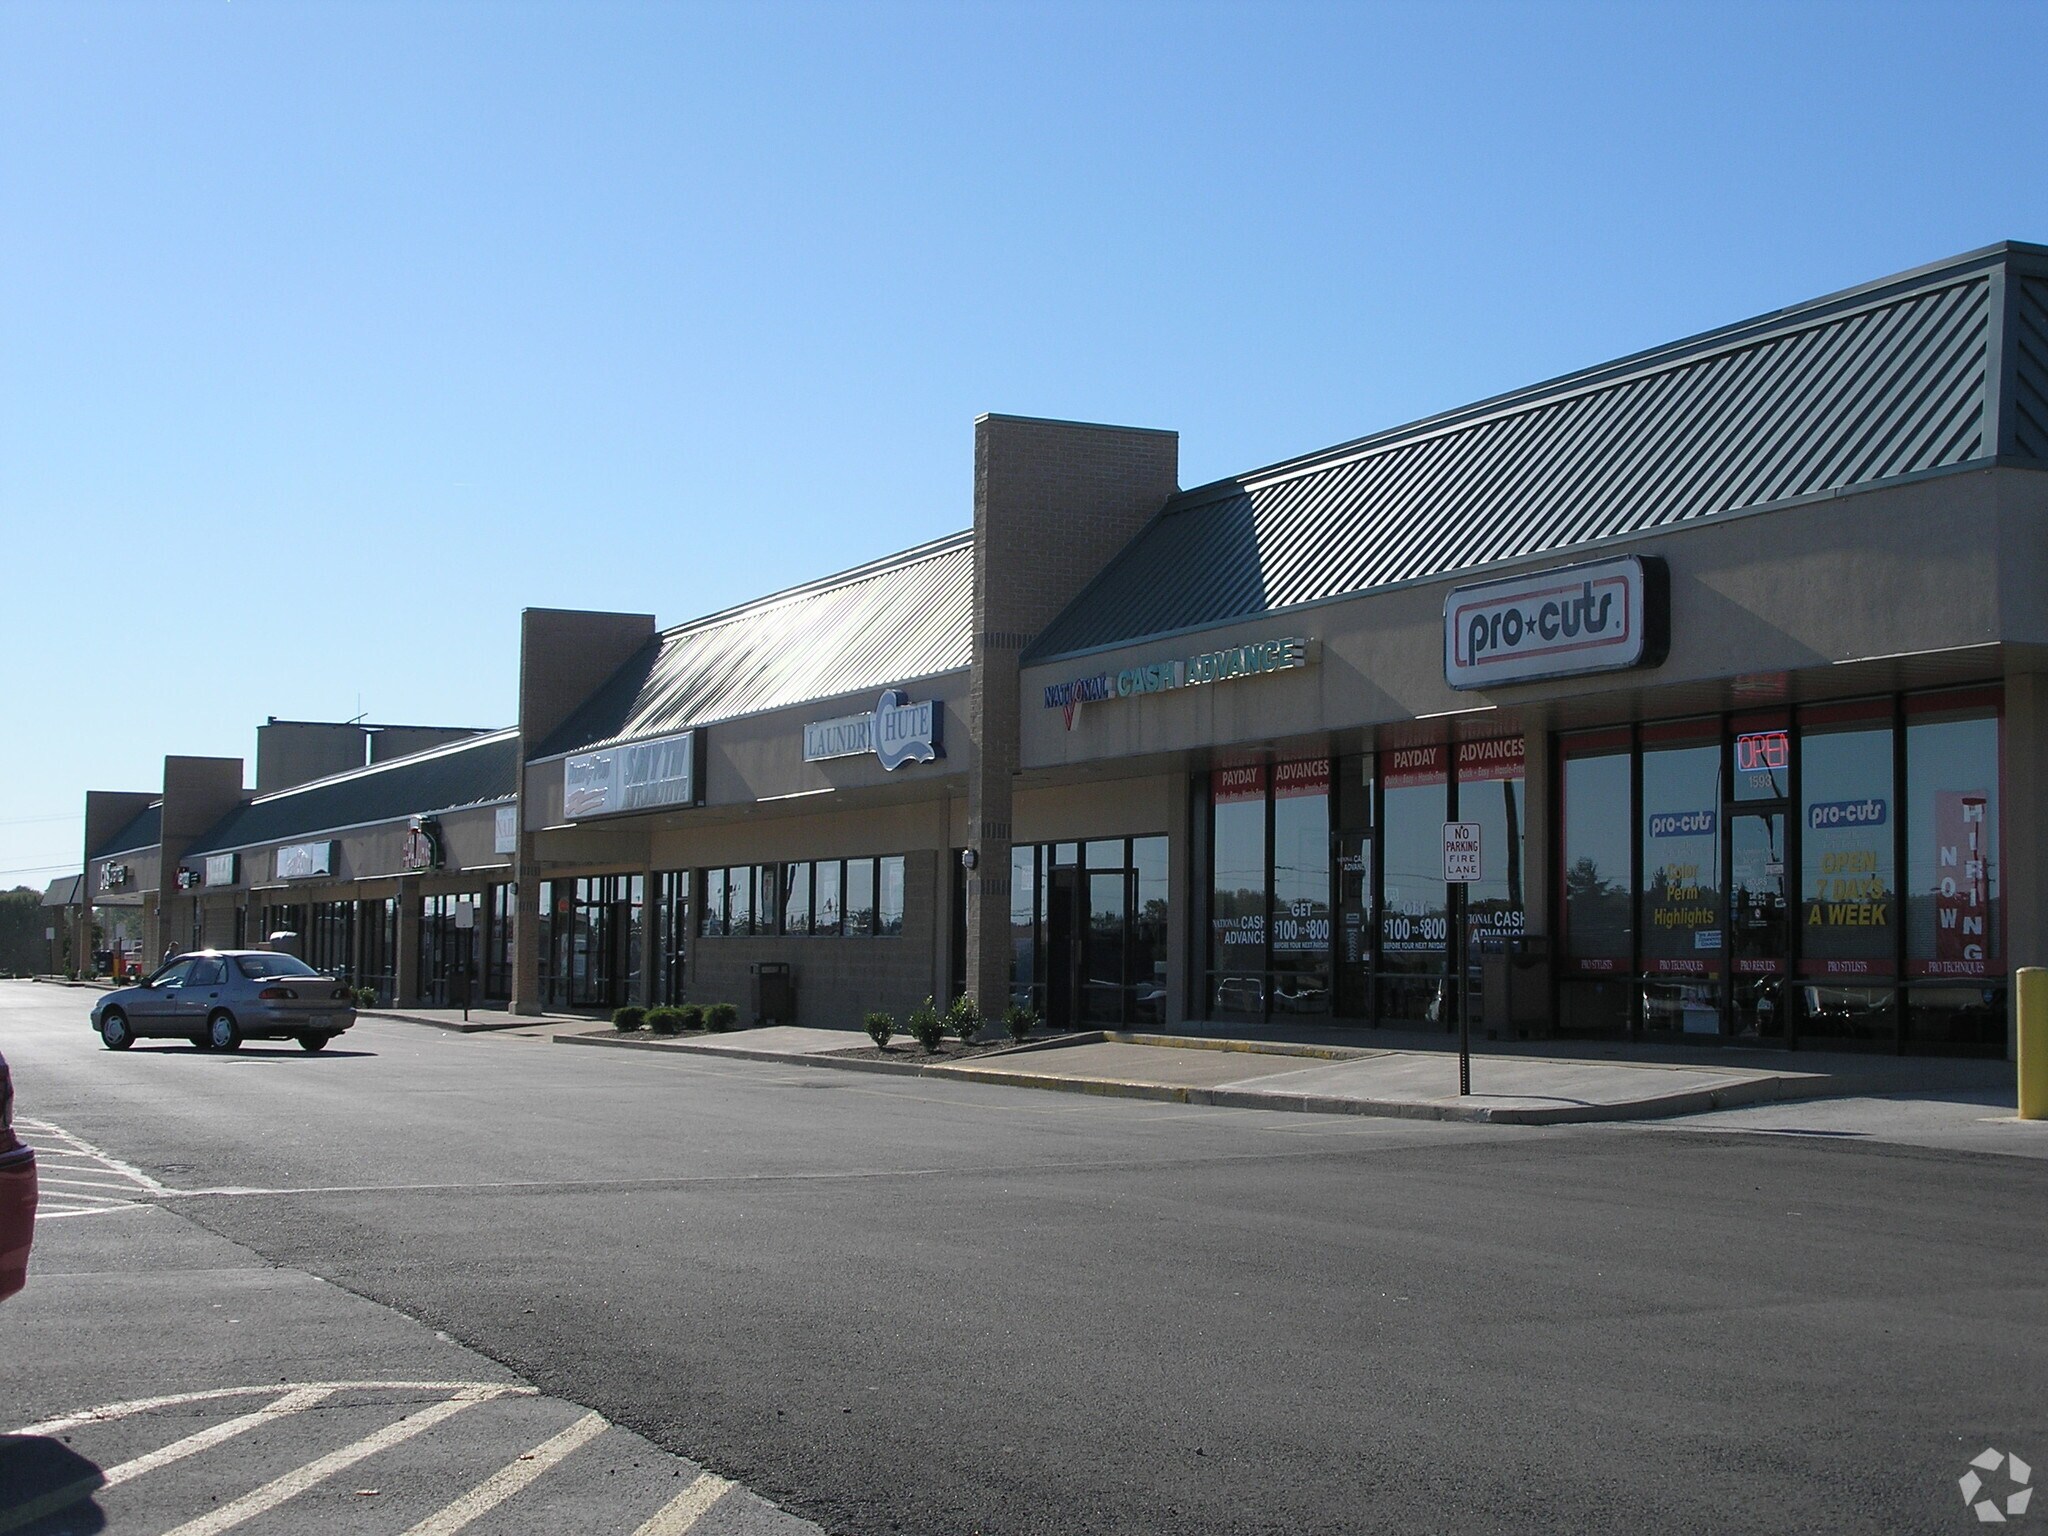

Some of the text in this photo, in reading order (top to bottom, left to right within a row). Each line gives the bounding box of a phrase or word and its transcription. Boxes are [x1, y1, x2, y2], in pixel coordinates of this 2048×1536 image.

[1043, 636, 1295, 709] NATIONAL CASH ADVANCE
[1394, 739, 1525, 768] PAYDAY ADVANCES
[1222, 759, 1329, 786] PAYDAY ADVANCES
[1748, 774, 1772, 789] 1593
[1652, 810, 1712, 838] pro-cuts
[1811, 800, 1882, 829] pro-cuts
[1454, 828, 1469, 839] NO
[1445, 840, 1478, 852] PARKING
[1449, 854, 1475, 863] FIRE
[1821, 851, 1877, 874] OPEN
[1447, 865, 1477, 874] LANE
[1666, 885, 1699, 902] Perm
[1291, 903, 1313, 917] GET
[1654, 908, 1714, 929] Highlights
[1808, 903, 1887, 926] A WEEK
[1274, 919, 1298, 940] $100
[1305, 919, 1330, 940] $800
[1384, 918, 1410, 940] $100
[1419, 917, 1447, 940] $800
[1827, 961, 1867, 972] PRO STYLISTS
[1928, 961, 1985, 974] PRO TECHNIQUES
